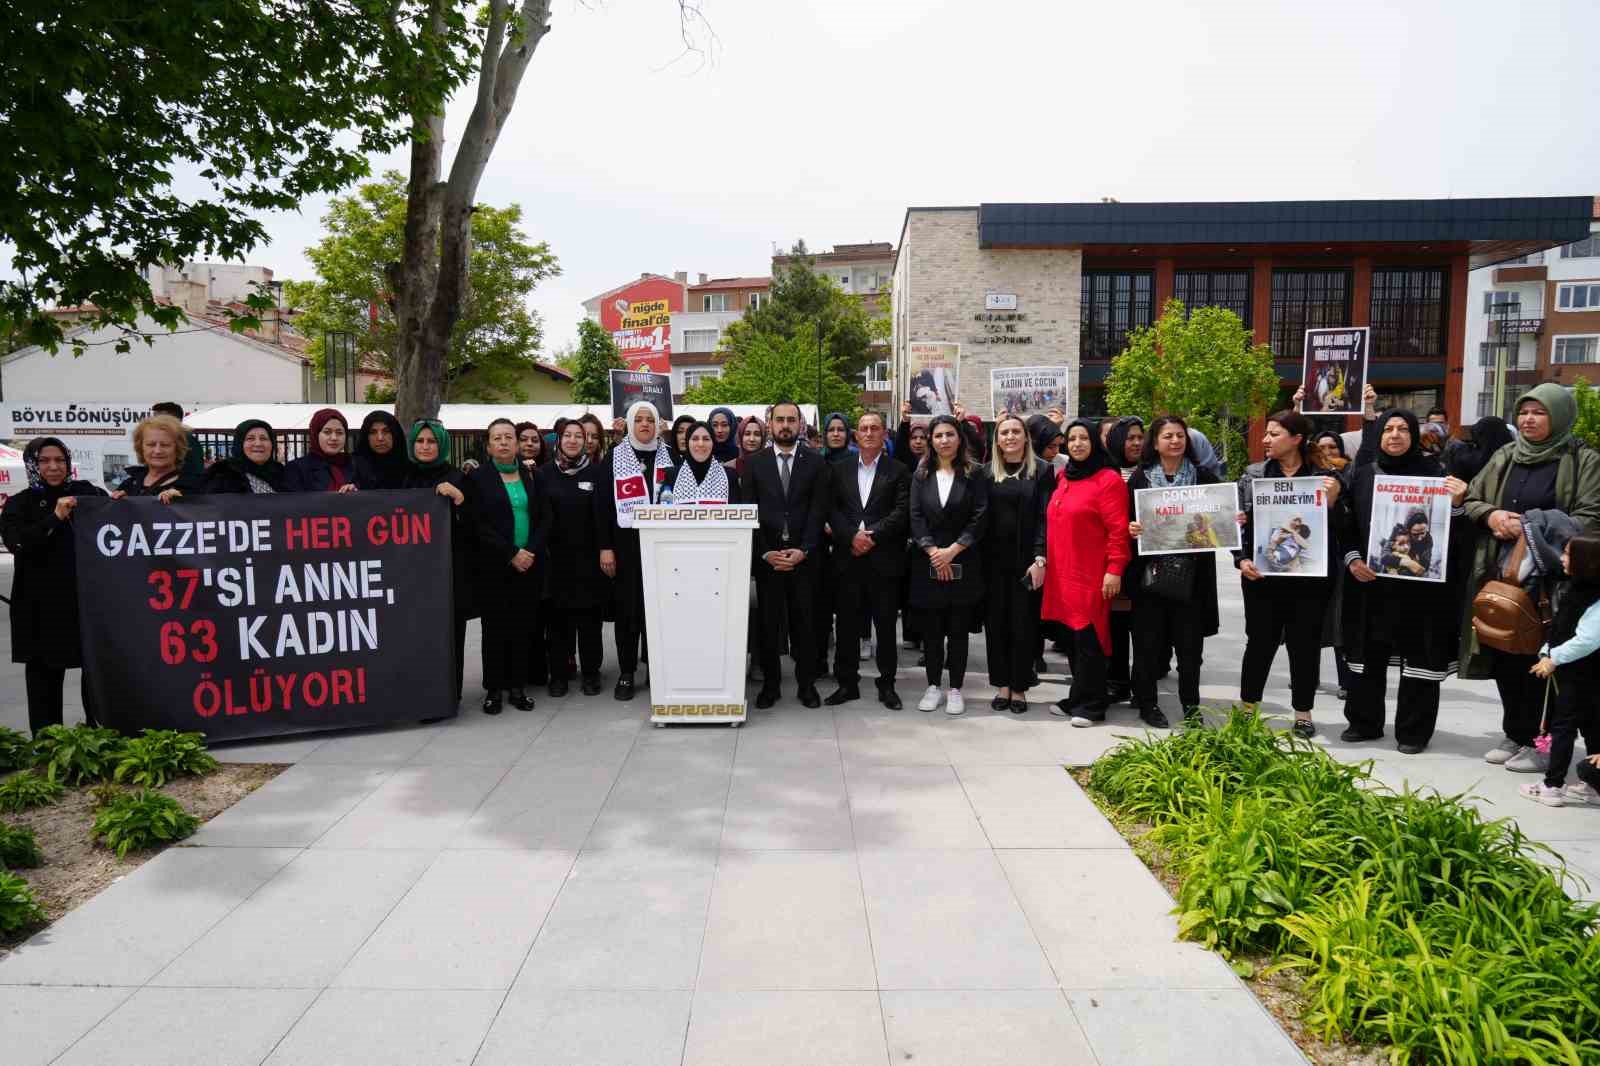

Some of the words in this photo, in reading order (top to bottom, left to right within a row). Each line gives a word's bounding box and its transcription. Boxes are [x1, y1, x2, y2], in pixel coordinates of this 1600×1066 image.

[12, 407, 62, 422] BÖYLE
[1256, 493, 1271, 505] BİR
[1274, 480, 1293, 492] BEN
[1392, 494, 1424, 504] OLMAK
[97, 519, 272, 557] GAZZE'DE
[285, 516, 352, 550] HER
[367, 507, 432, 545] GÜN
[147, 557, 256, 610] 37'Sİ
[275, 560, 395, 605] ANNE,
[160, 619, 218, 665] 63
[238, 608, 378, 660] KADIN
[193, 667, 366, 718] ÖLÜYOR!
